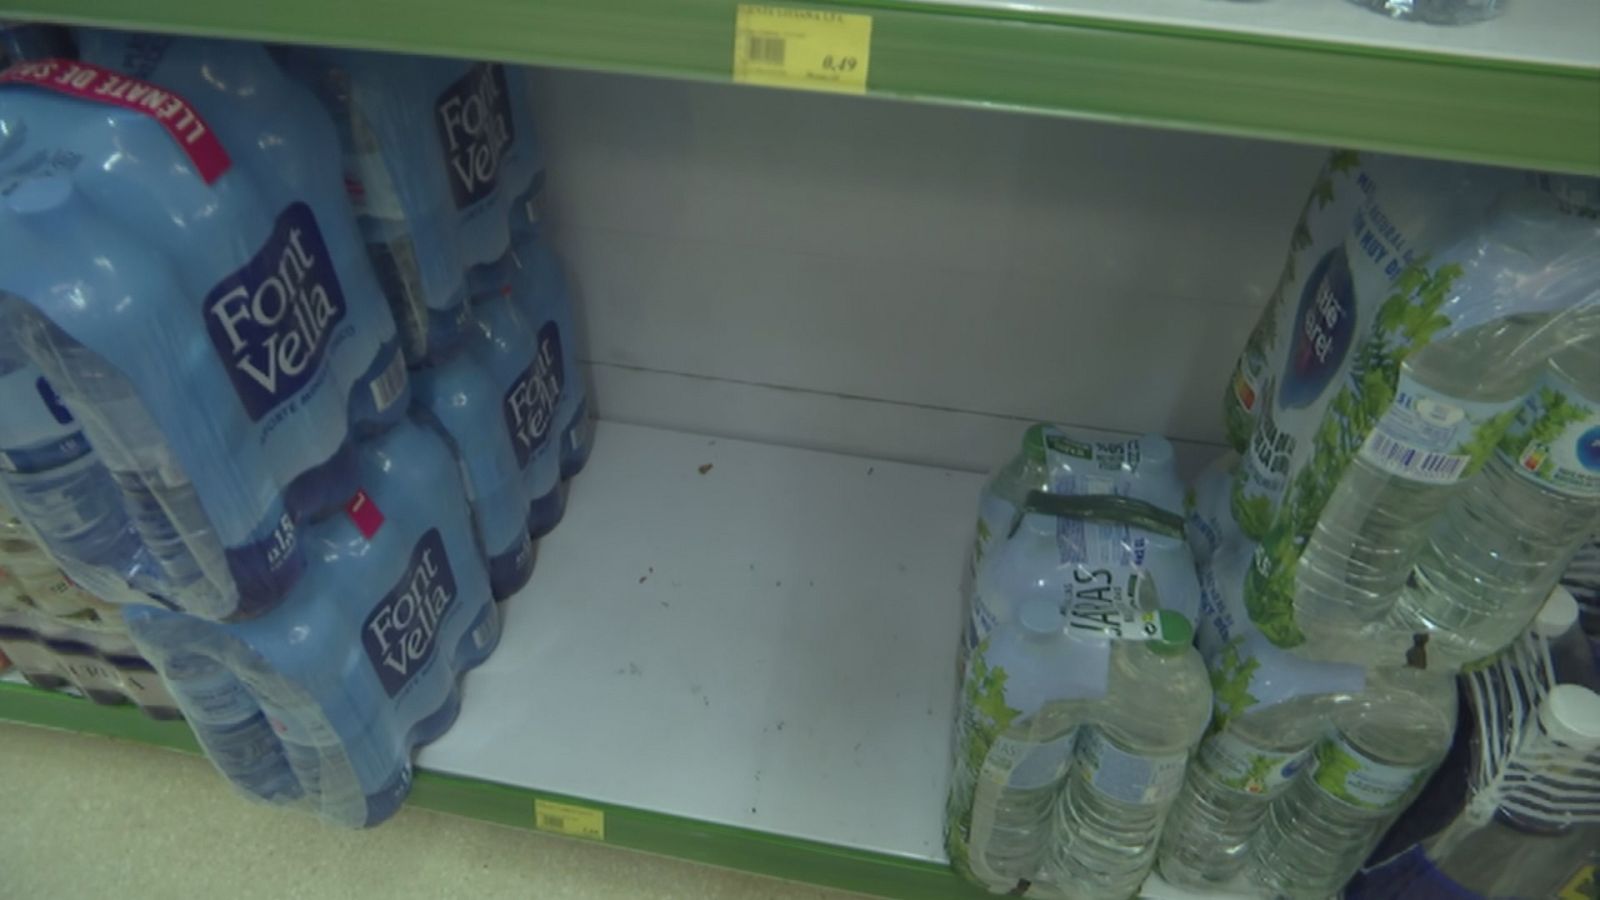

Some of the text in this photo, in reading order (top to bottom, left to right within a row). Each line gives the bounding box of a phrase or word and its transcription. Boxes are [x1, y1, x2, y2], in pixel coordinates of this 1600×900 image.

[210, 227, 314, 354] Font
[238, 282, 338, 395] Vella
[367, 545, 440, 653] Font
[383, 584, 455, 681] Vella
